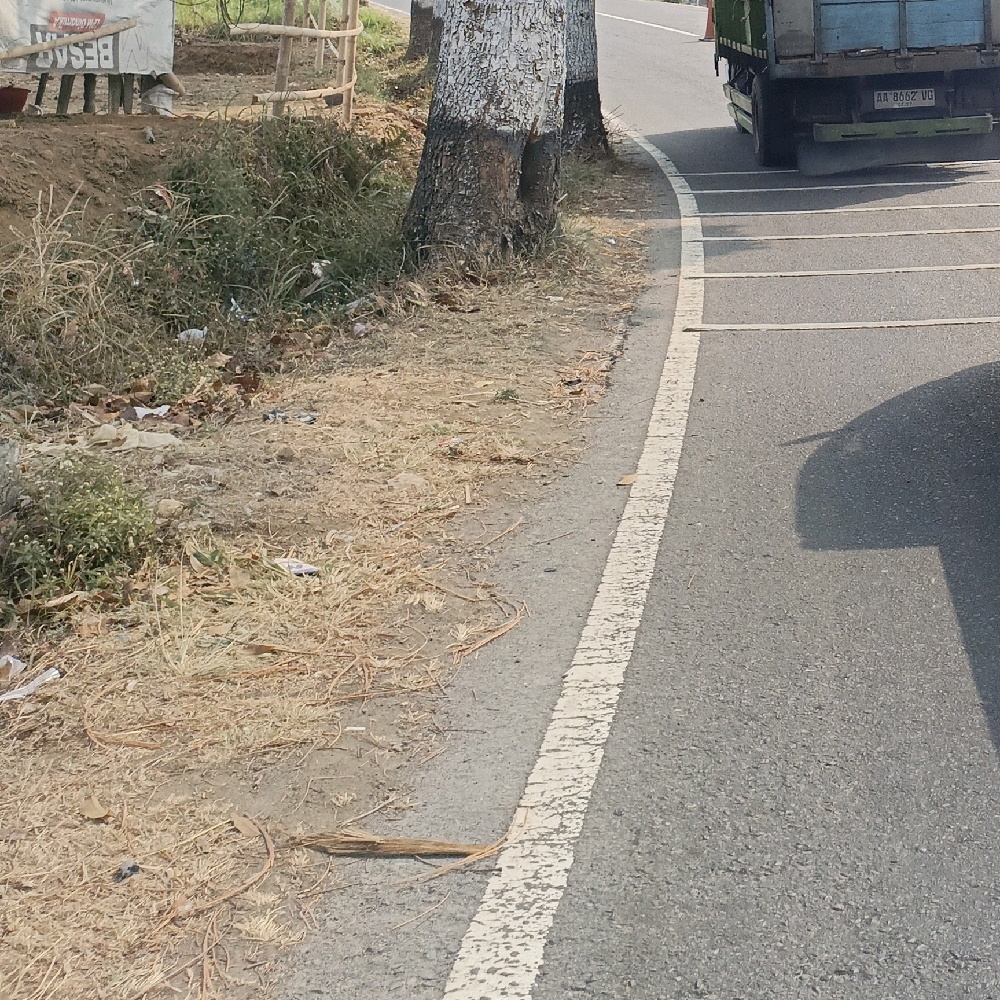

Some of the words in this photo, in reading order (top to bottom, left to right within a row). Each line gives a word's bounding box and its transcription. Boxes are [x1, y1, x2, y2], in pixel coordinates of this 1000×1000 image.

[876, 93, 889, 103] AA
[893, 90, 918, 102] 8662
[921, 90, 934, 101] VG
